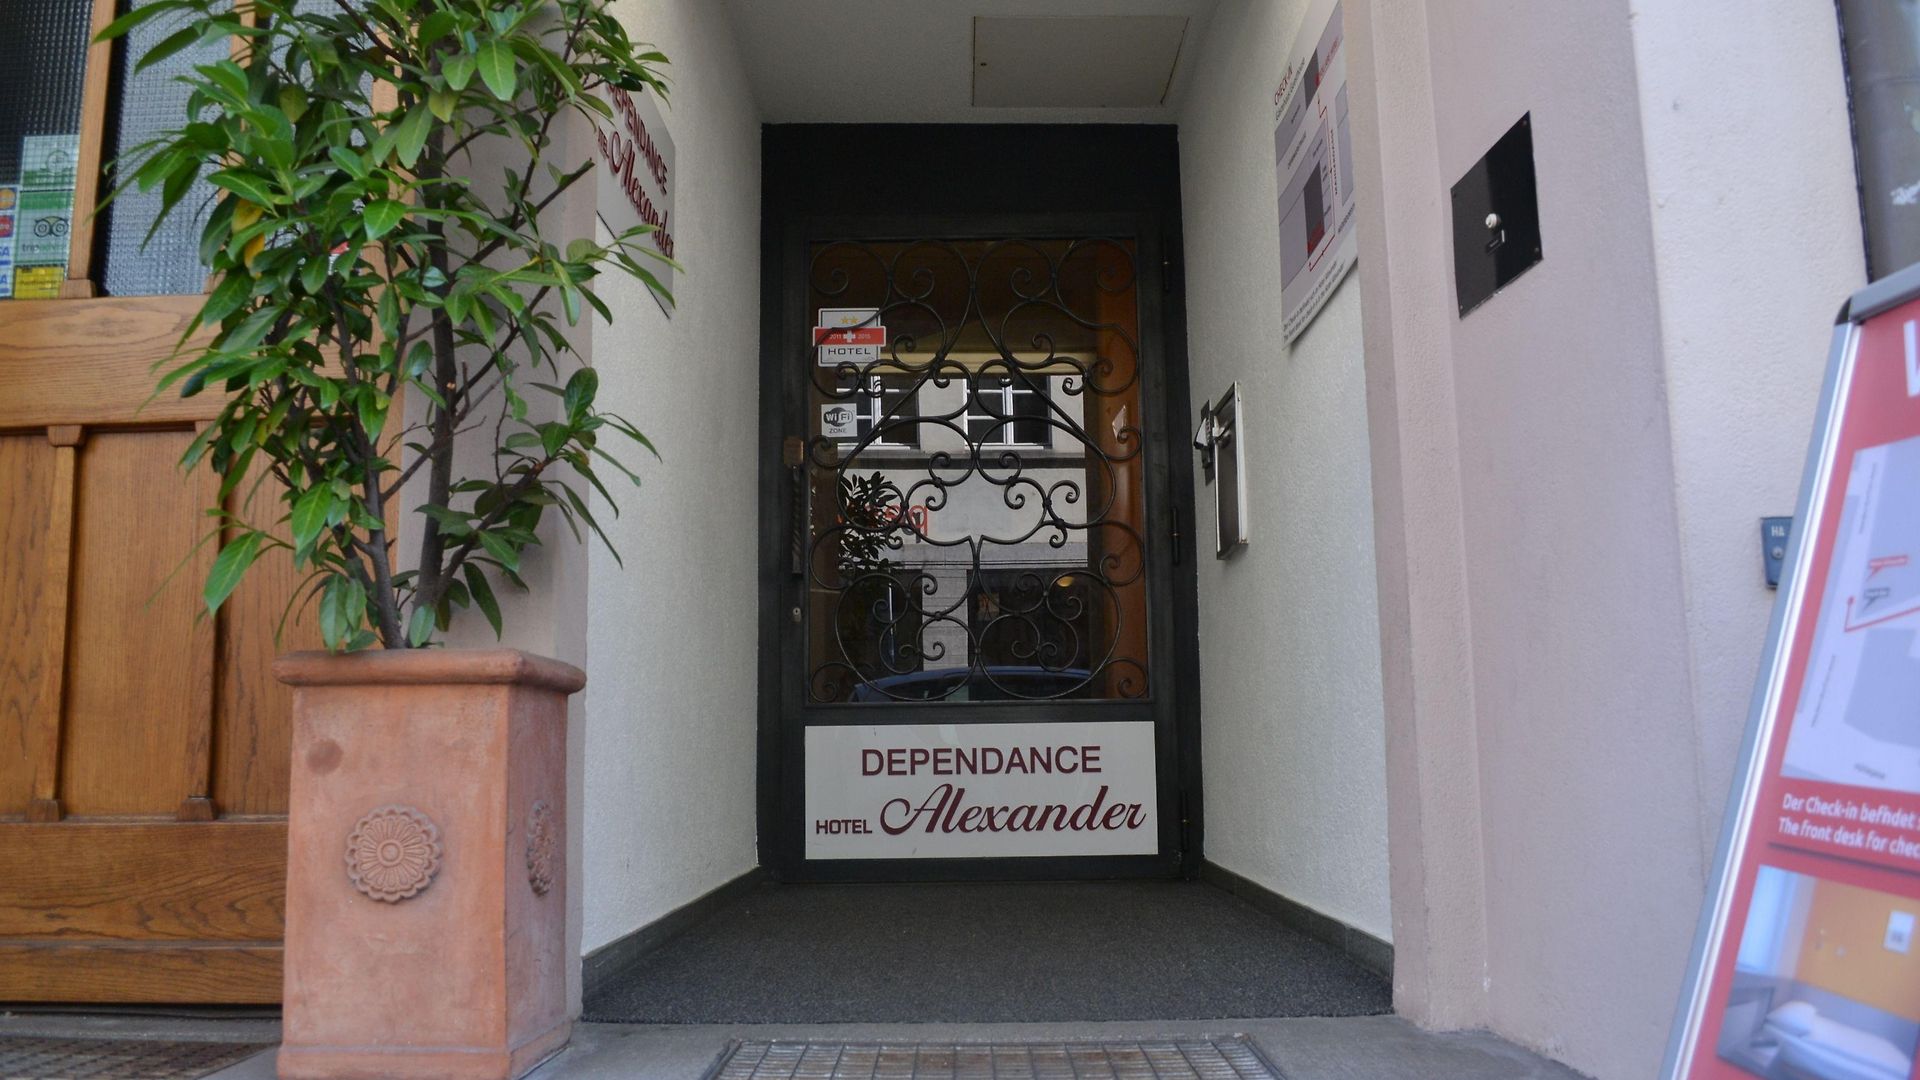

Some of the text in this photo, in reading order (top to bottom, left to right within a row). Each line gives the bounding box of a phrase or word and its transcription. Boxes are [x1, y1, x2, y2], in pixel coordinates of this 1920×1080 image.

[609, 130, 674, 260] Alexander
[828, 347, 871, 355] HOTEL
[862, 745, 1102, 776] DEPENDANCE
[816, 783, 1147, 836] HOTEL Alexander
[1782, 792, 1804, 812] Der
[1805, 796, 1858, 820] Check-in
[1779, 816, 1920, 860] The front desk for chec
